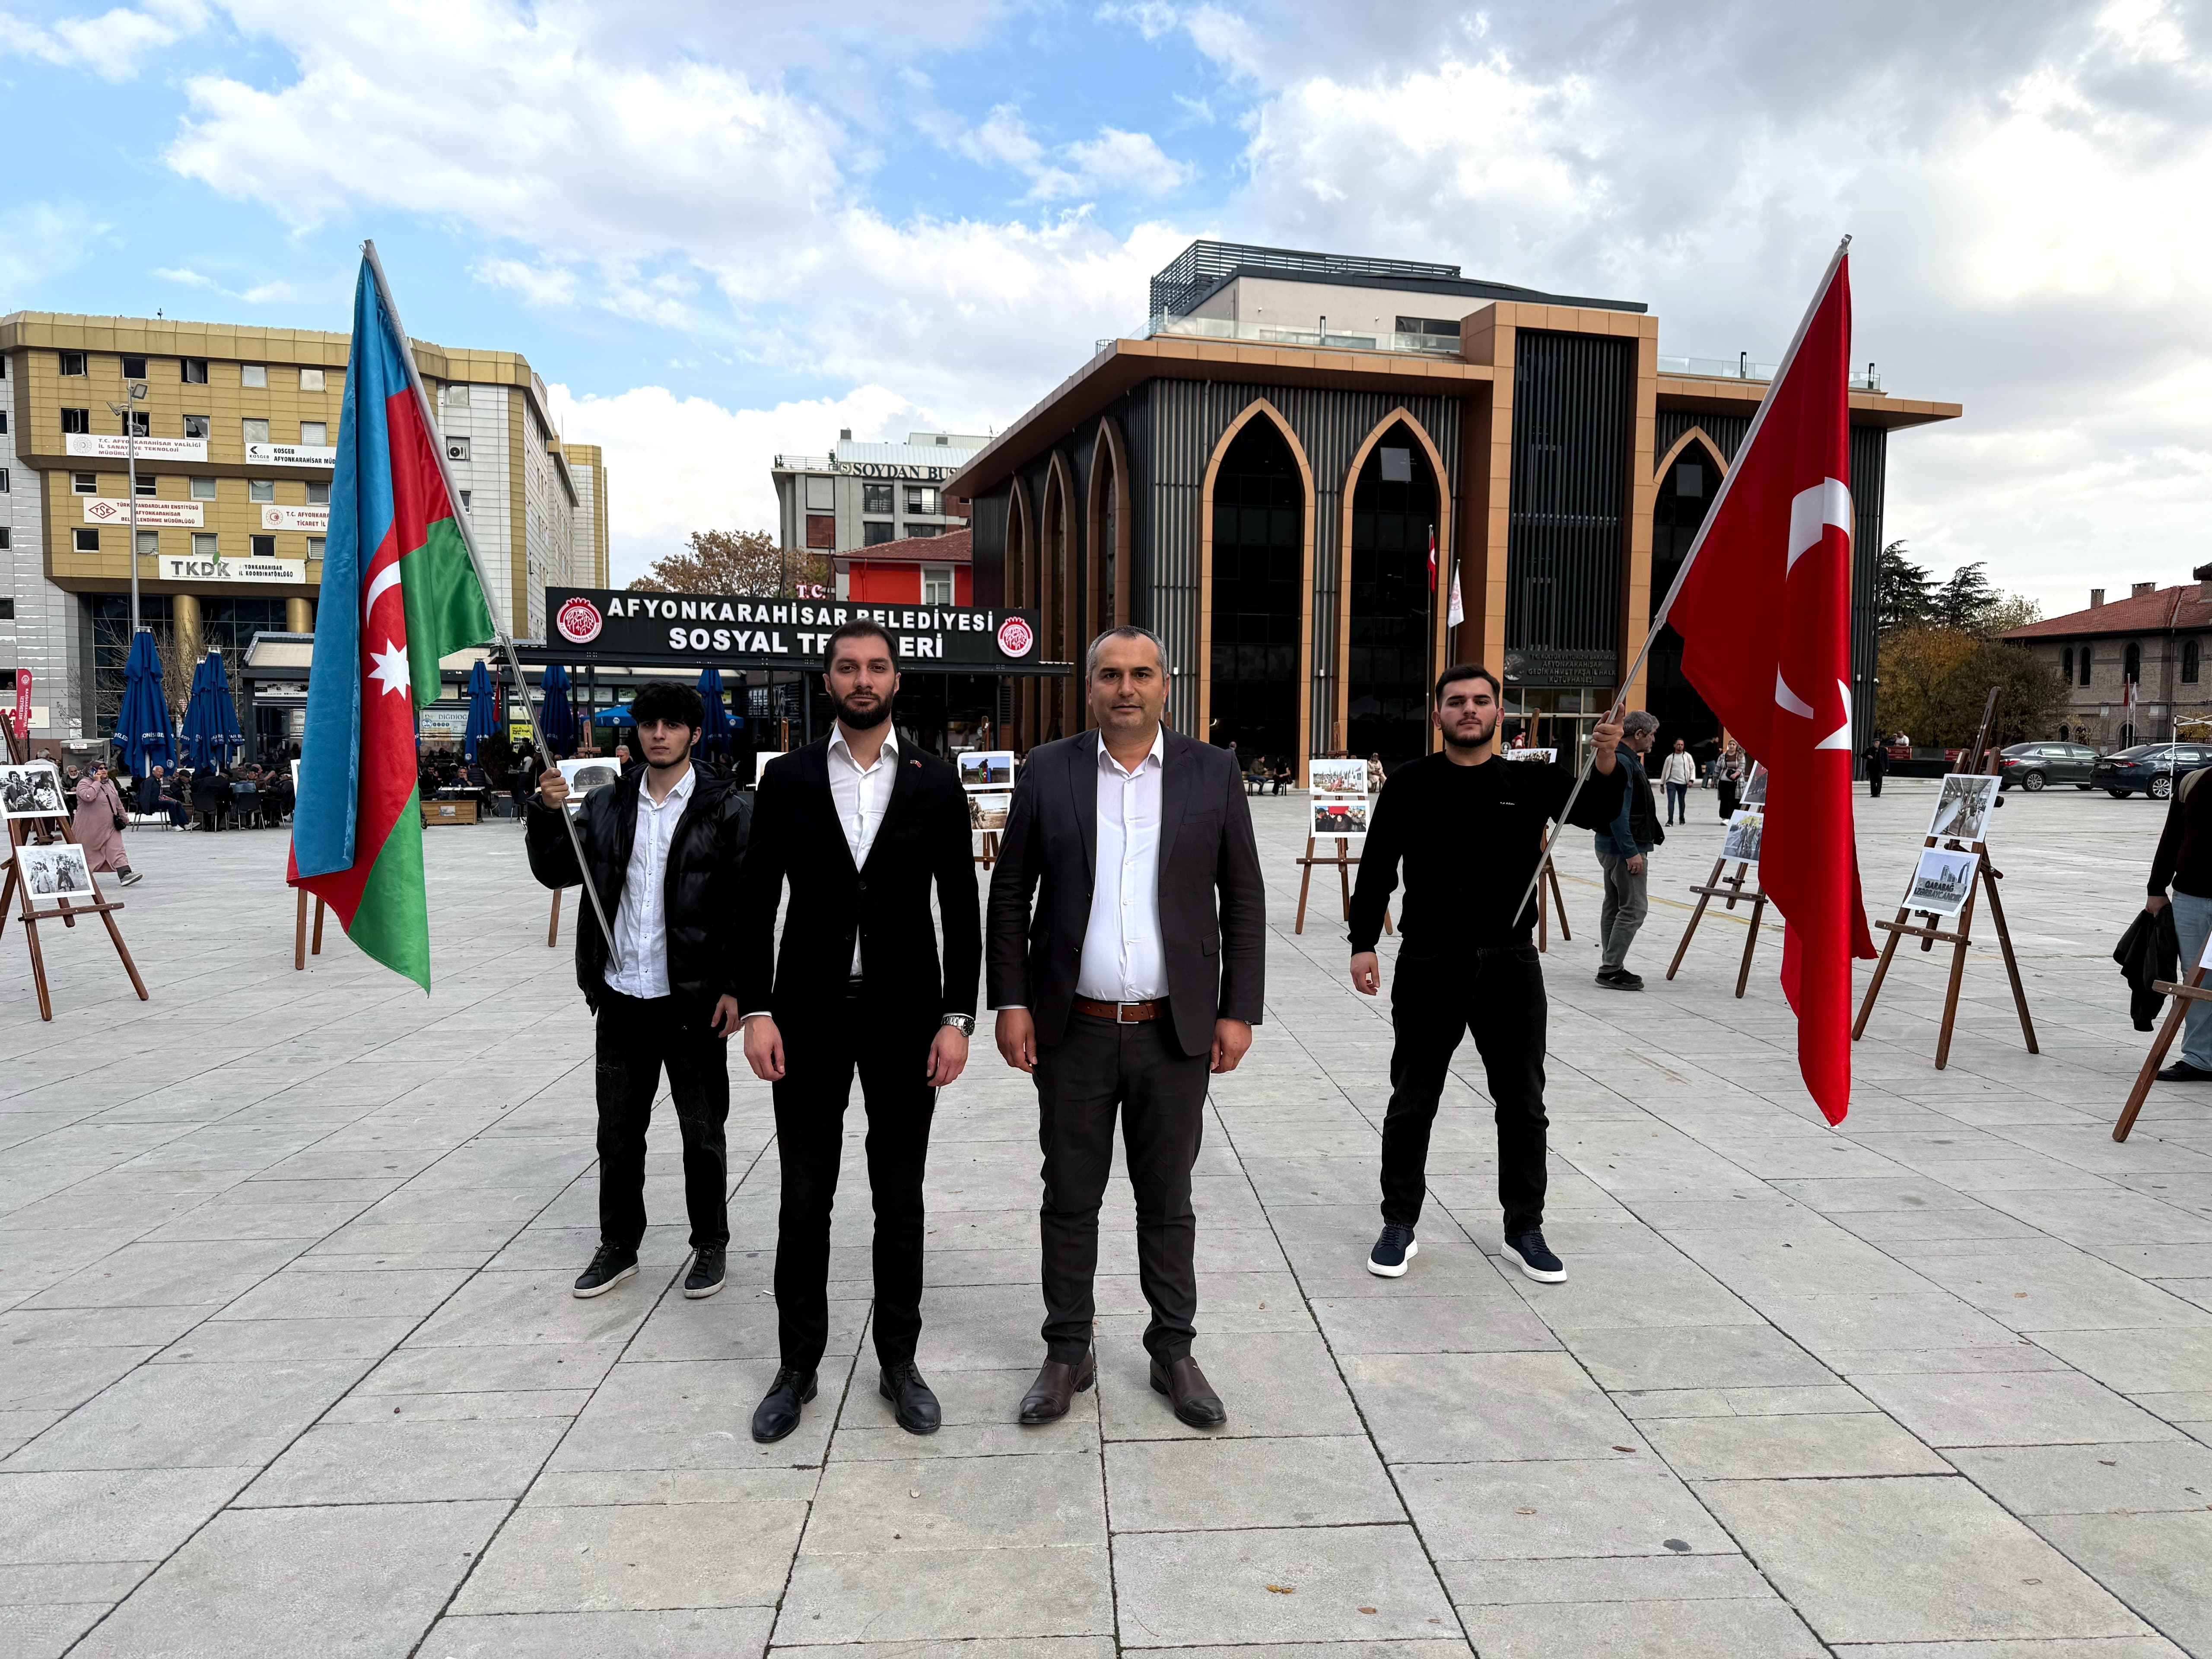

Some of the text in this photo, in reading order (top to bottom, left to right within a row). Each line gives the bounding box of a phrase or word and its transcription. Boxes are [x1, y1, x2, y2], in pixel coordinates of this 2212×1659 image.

[853, 463, 920, 478] SOYDAN
[95, 505, 110, 516] TSE
[171, 560, 231, 577] TKDK
[796, 584, 826, 599] T.C.
[607, 597, 848, 627] AFYONKARAHİSAR
[669, 628, 943, 658] SOSYAL TEERİ
[1925, 880, 1955, 892] QARABAĞ
